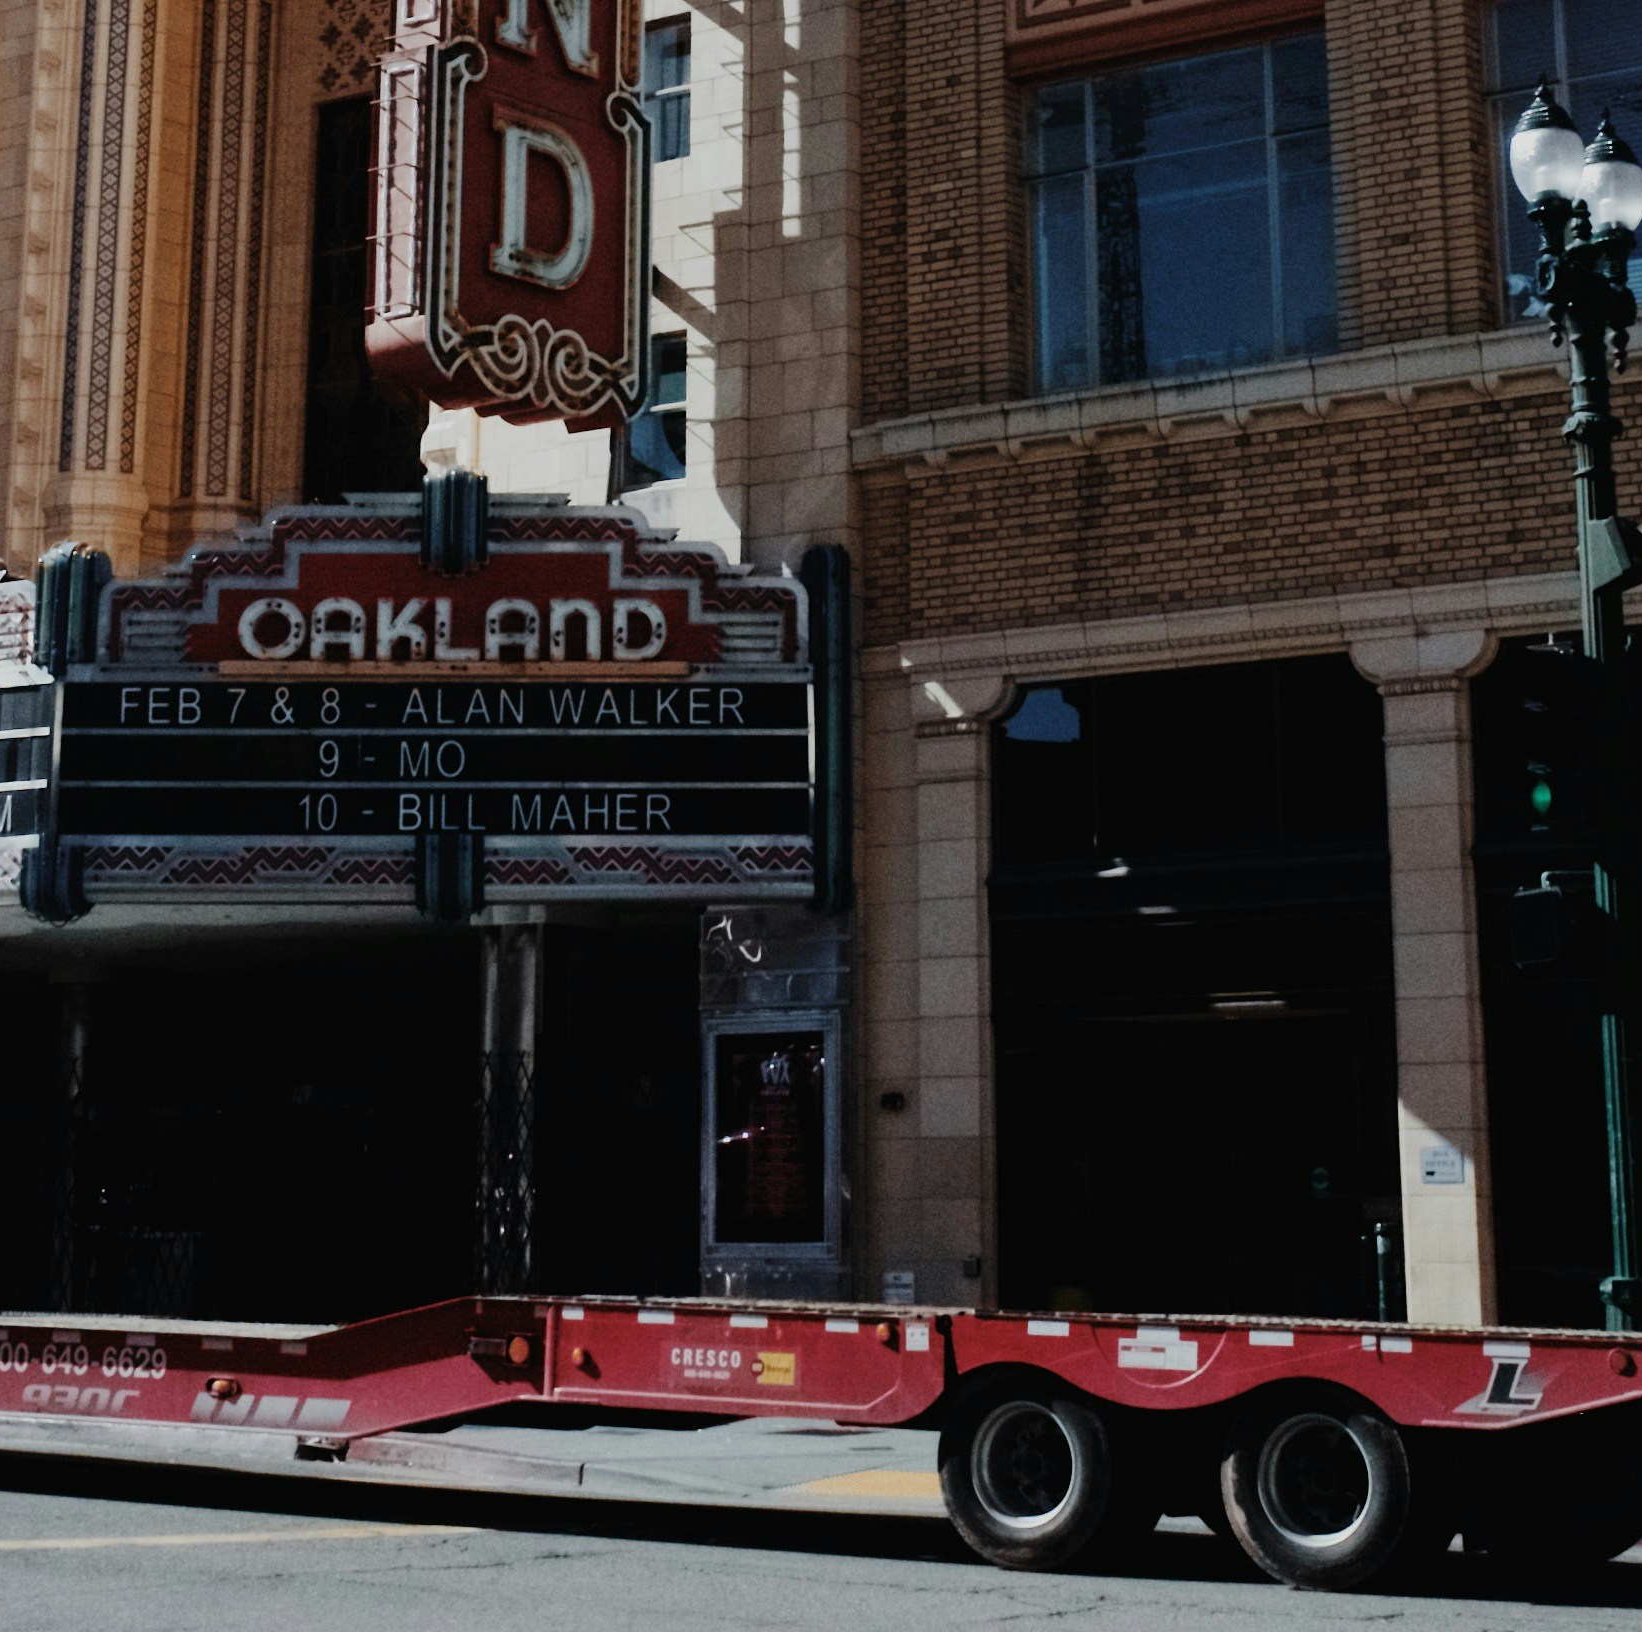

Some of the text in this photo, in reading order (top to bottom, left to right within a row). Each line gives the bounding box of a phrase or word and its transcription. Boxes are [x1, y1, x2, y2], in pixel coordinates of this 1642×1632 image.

[238, 597, 668, 660] OAKLAND
[120, 687, 202, 724] FEB
[227, 687, 246, 724] 7
[270, 686, 295, 724] &
[320, 686, 341, 724] 8
[402, 687, 524, 724] ALAN
[549, 687, 744, 724] WALKER
[319, 739, 340, 778] 9
[399, 739, 466, 778] MO
[299, 792, 338, 831] 10
[398, 793, 486, 831] BILL
[511, 793, 672, 831] MAHER
[671, 1347, 742, 1369] CRESCO
